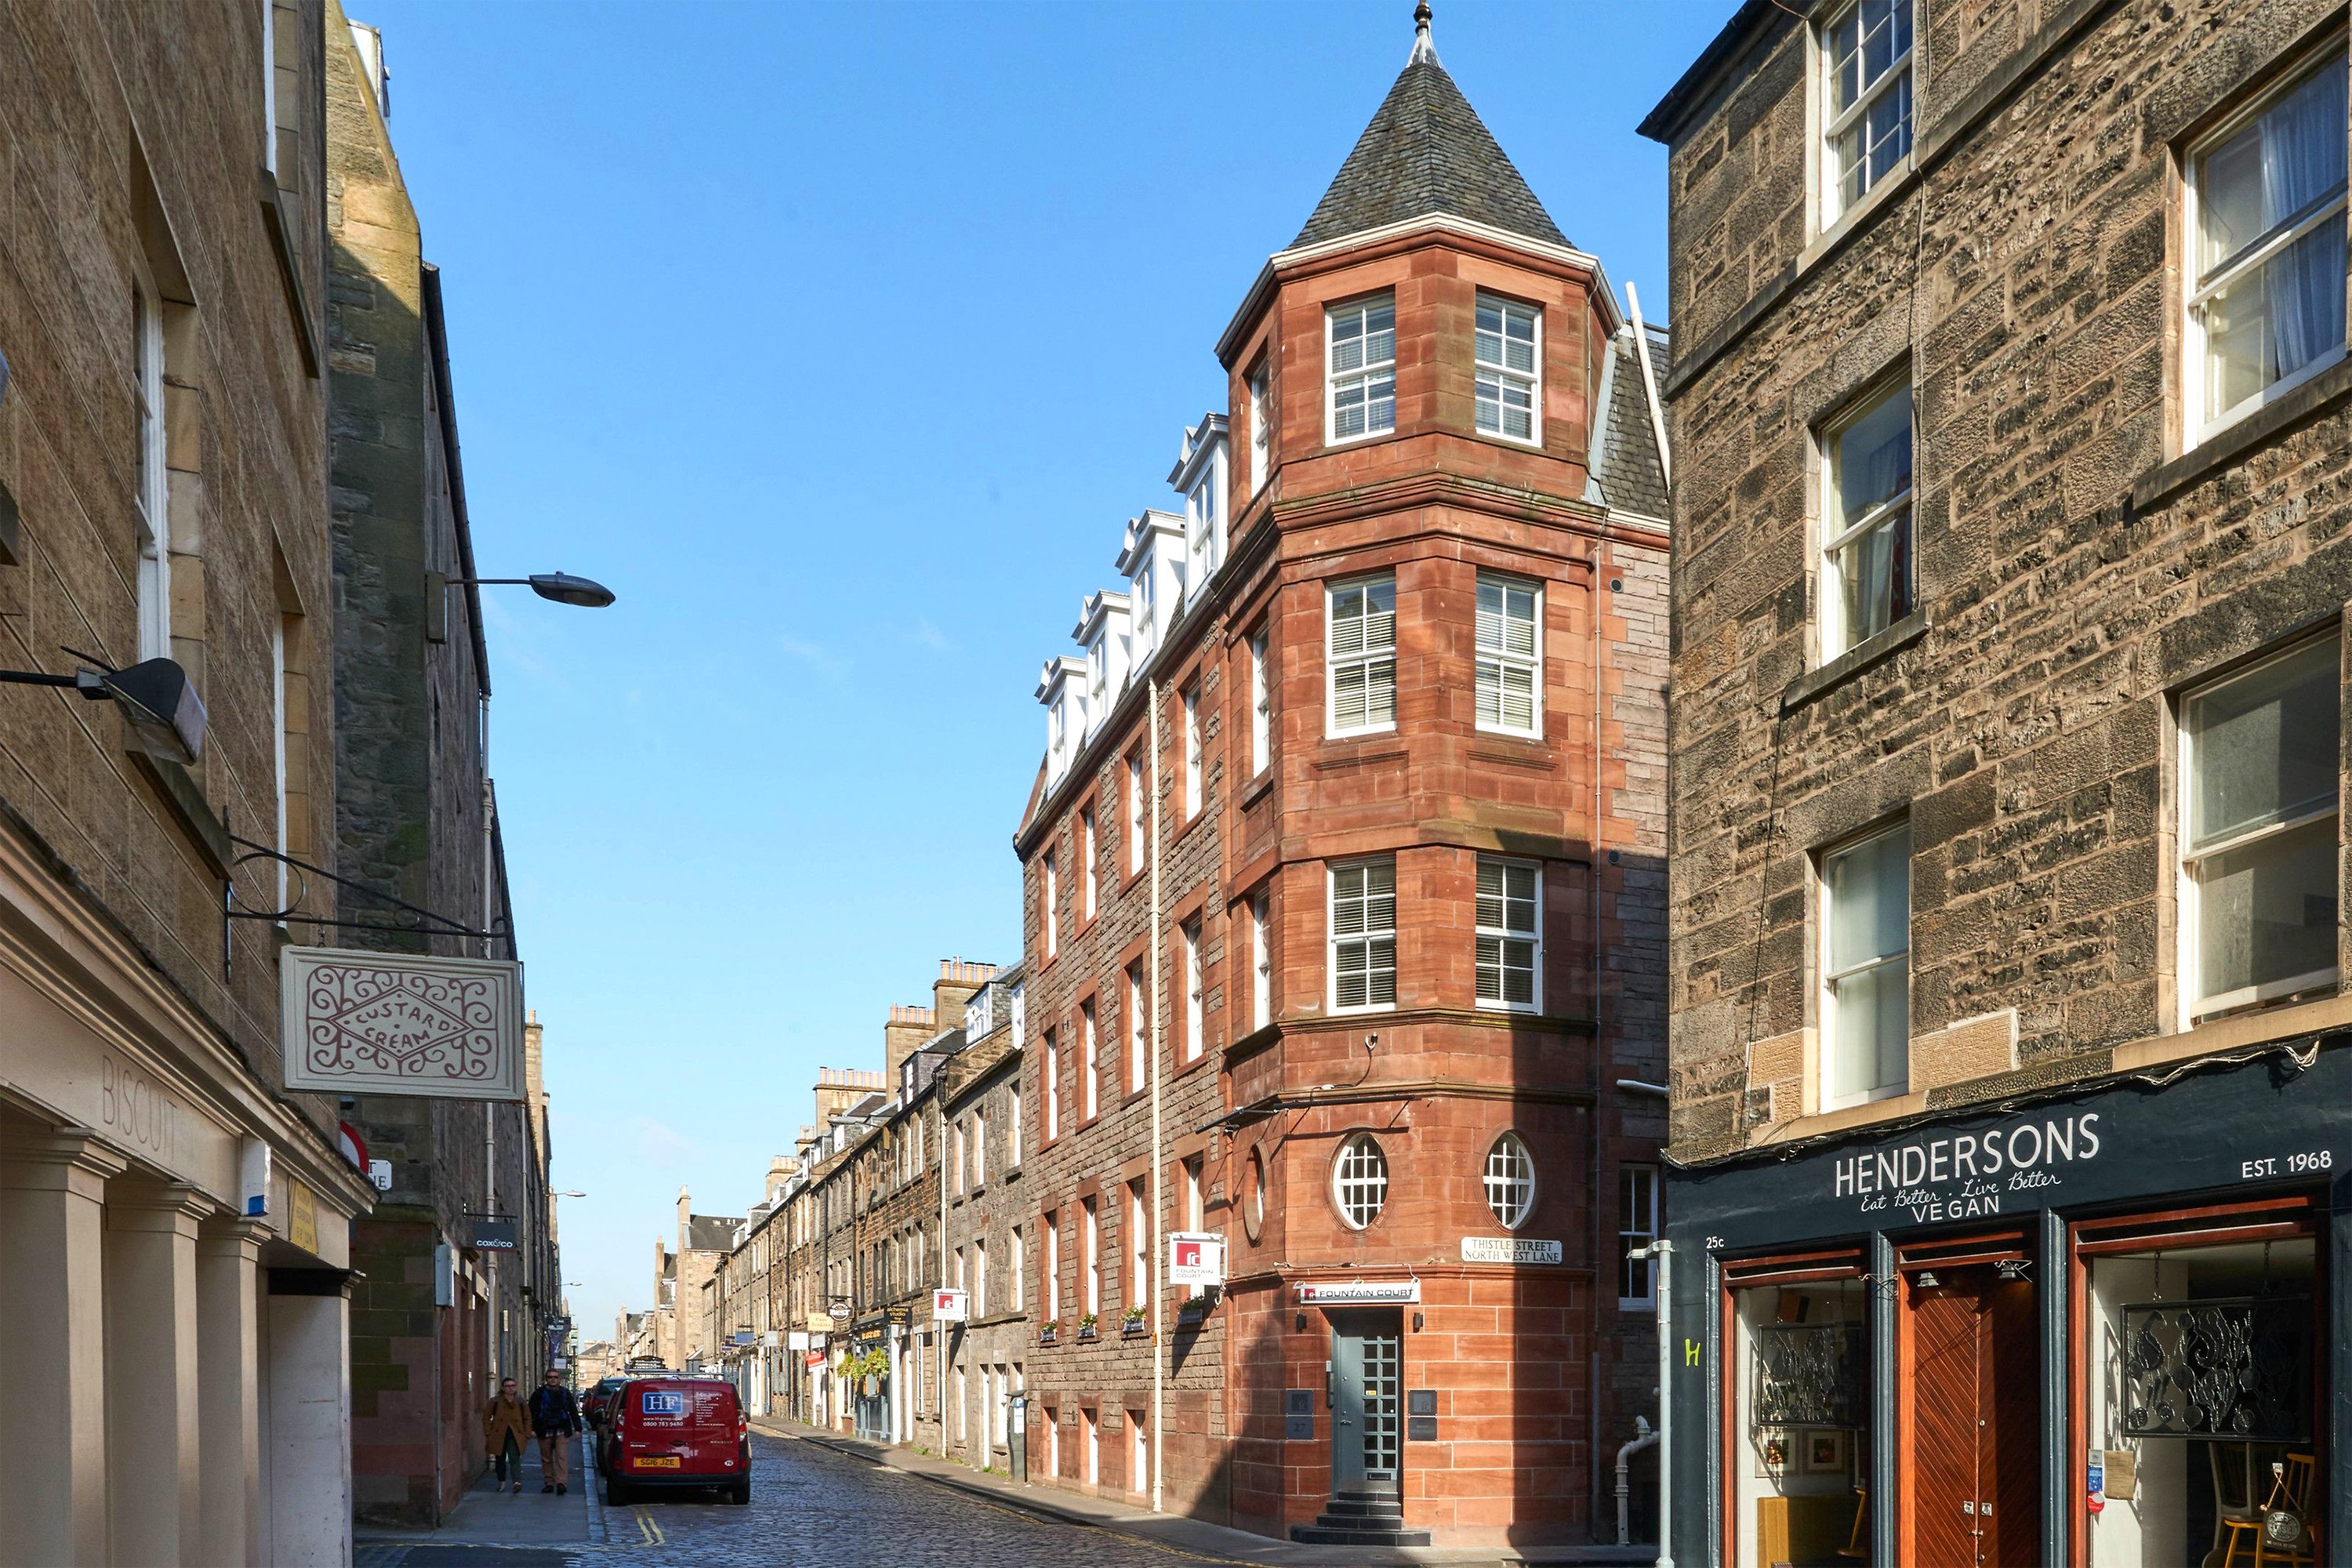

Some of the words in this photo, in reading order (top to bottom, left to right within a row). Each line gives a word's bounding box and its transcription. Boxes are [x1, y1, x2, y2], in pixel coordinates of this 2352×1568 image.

[356, 1002, 449, 1031] CUSTARD
[365, 1027, 430, 1049] CREAM
[103, 1054, 177, 1162] BISCUIT
[1835, 1113, 2100, 1197] HENDERSONS
[2242, 1158, 2277, 1178] EST.
[2287, 1150, 2332, 1172] 1968
[1861, 1195, 1886, 1212] Eat
[1894, 1189, 1940, 1207] Better
[1962, 1179, 1999, 1198] Live
[2008, 1171, 2061, 1190] Better
[1911, 1196, 1999, 1223] VEGAN
[1465, 1250, 1500, 1260] NORTH
[1503, 1251, 1531, 1261] WEST
[1534, 1252, 1559, 1262] LANE
[1472, 1240, 1512, 1250] THISTLE
[1515, 1241, 1553, 1251] STREET
[648, 1396, 678, 1410] HF
[1294, 1423, 1306, 1432] 27
